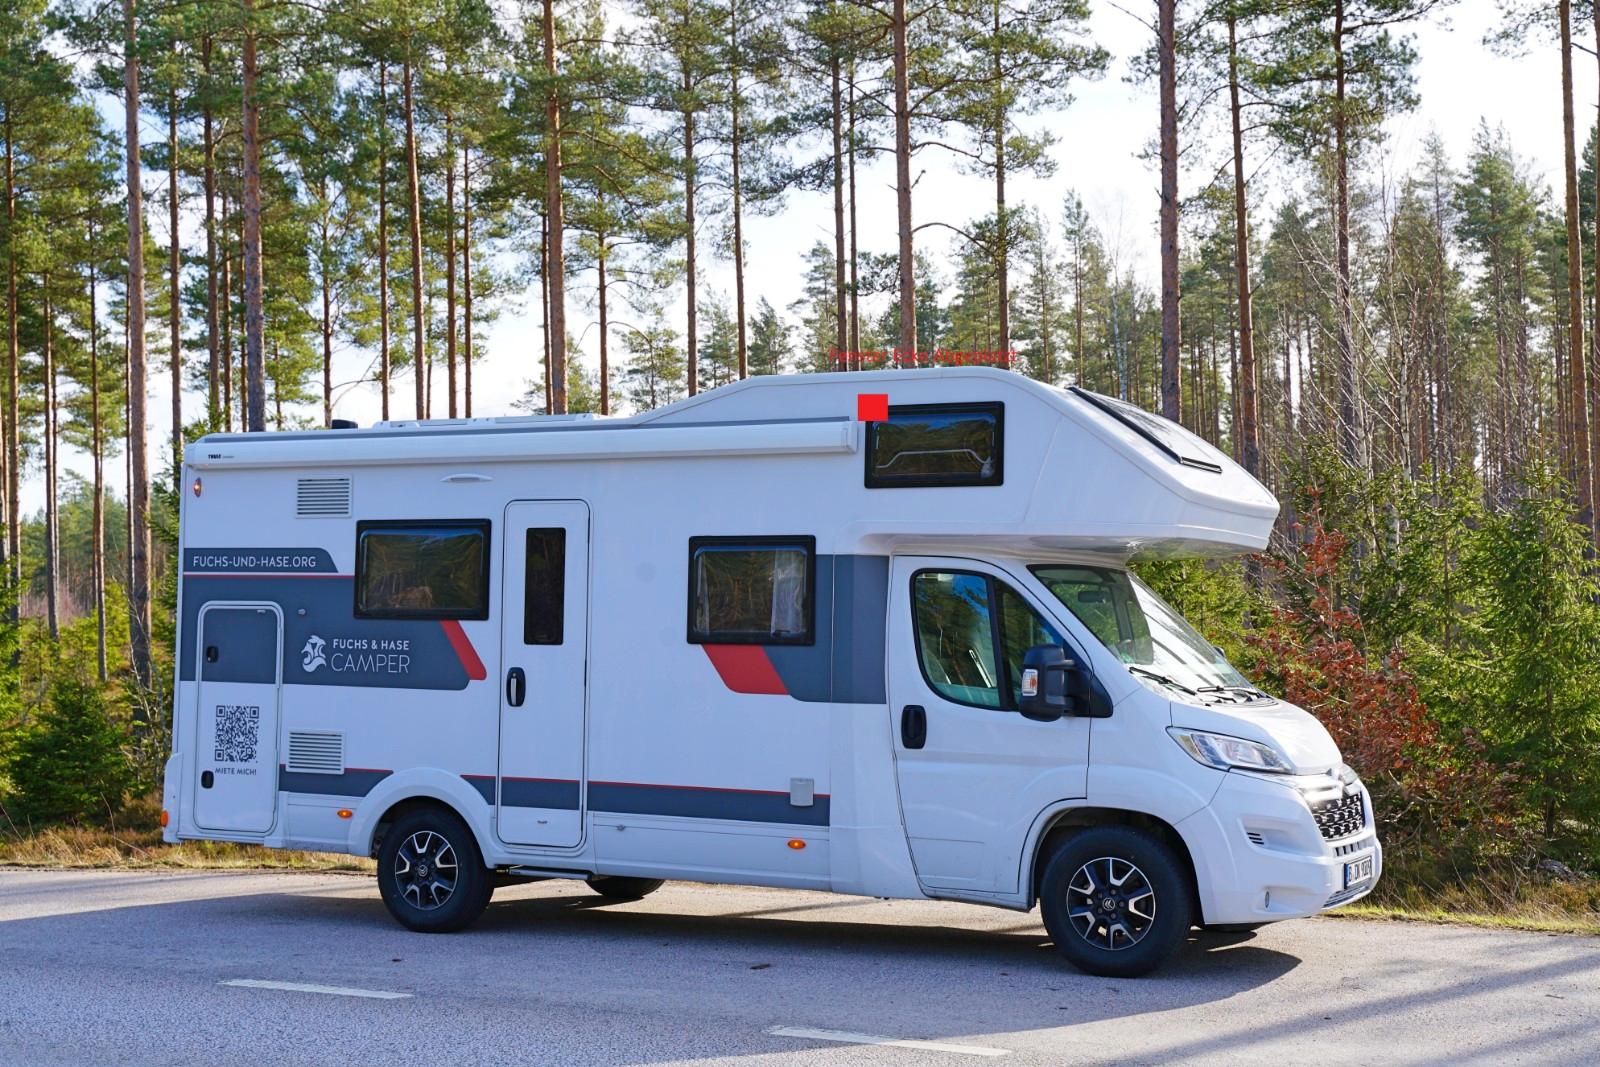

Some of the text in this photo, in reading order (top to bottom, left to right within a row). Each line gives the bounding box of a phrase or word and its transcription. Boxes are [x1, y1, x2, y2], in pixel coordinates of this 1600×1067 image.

[193, 556, 316, 567] FUCHS-UND-HASE.ORG
[332, 638, 410, 650] FUCHS & HASE
[331, 653, 410, 673] CAMPER
